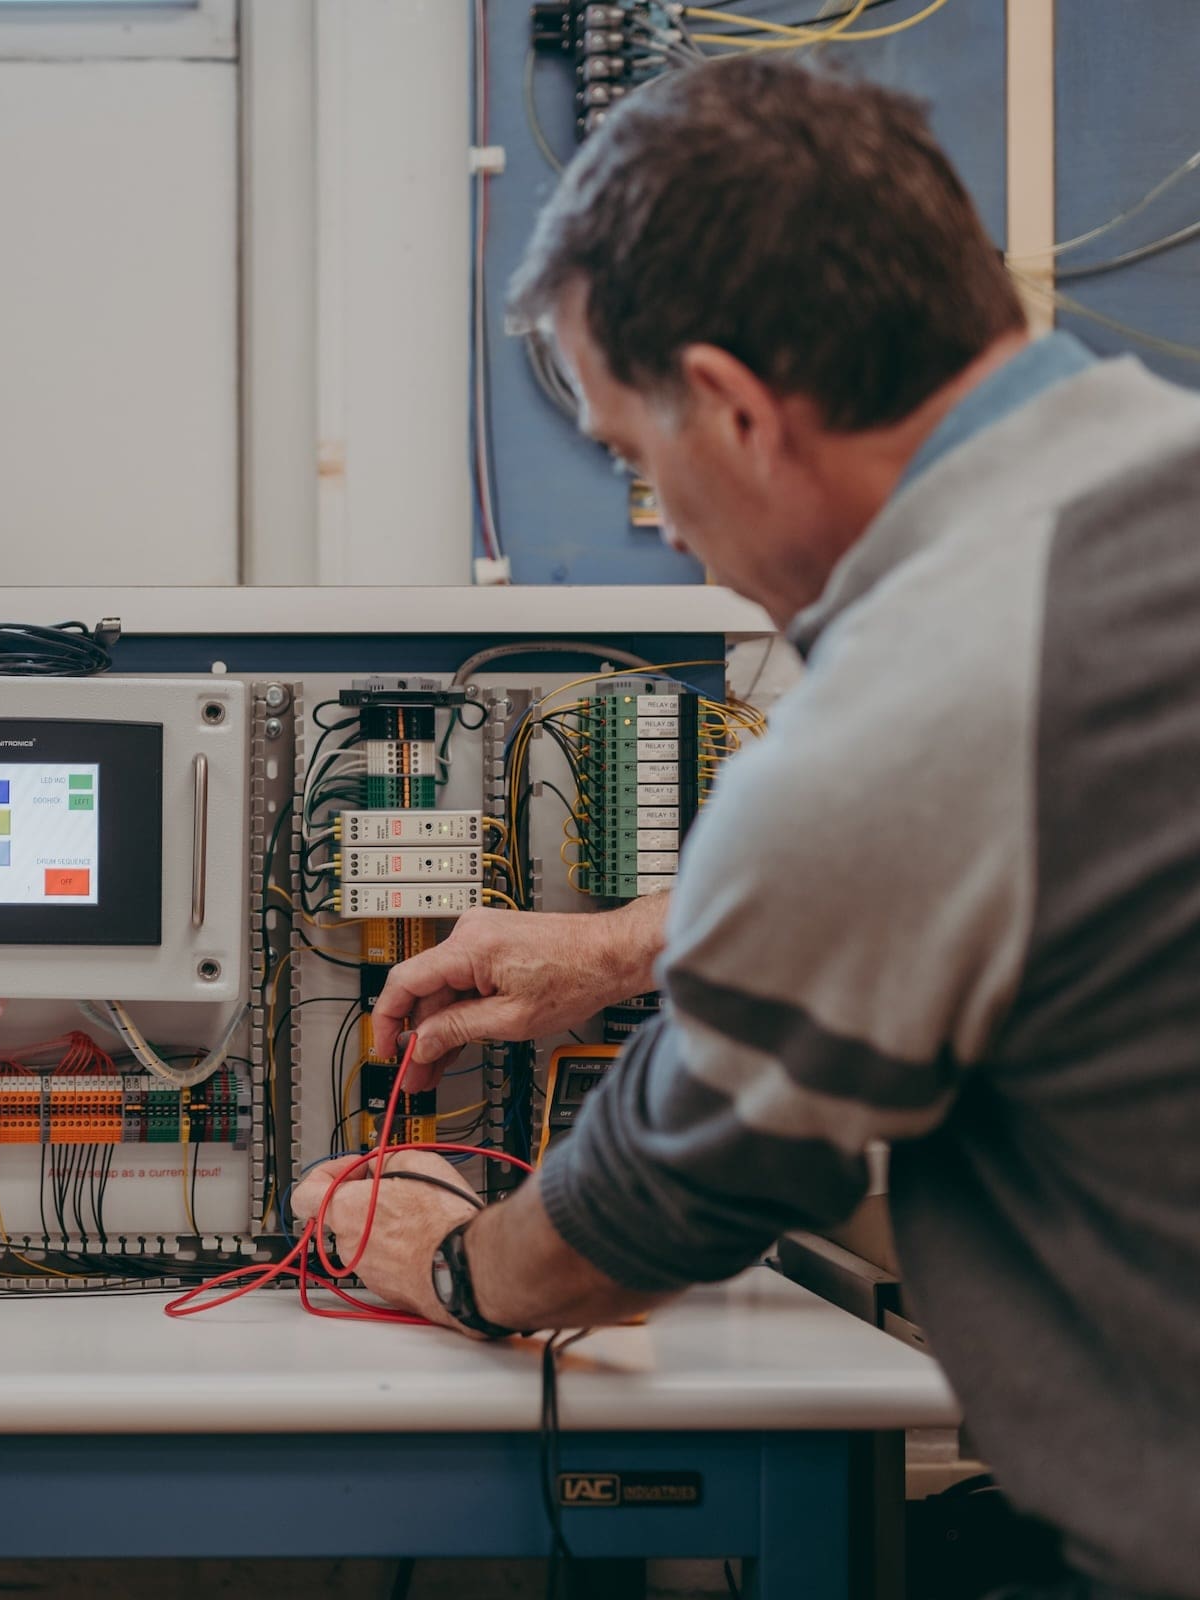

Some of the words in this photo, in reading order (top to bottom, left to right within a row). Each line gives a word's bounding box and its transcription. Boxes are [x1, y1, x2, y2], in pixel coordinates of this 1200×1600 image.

[122, 1170, 135, 1178] as
[138, 1170, 145, 1178] a
[565, 1479, 613, 1500] IAC
